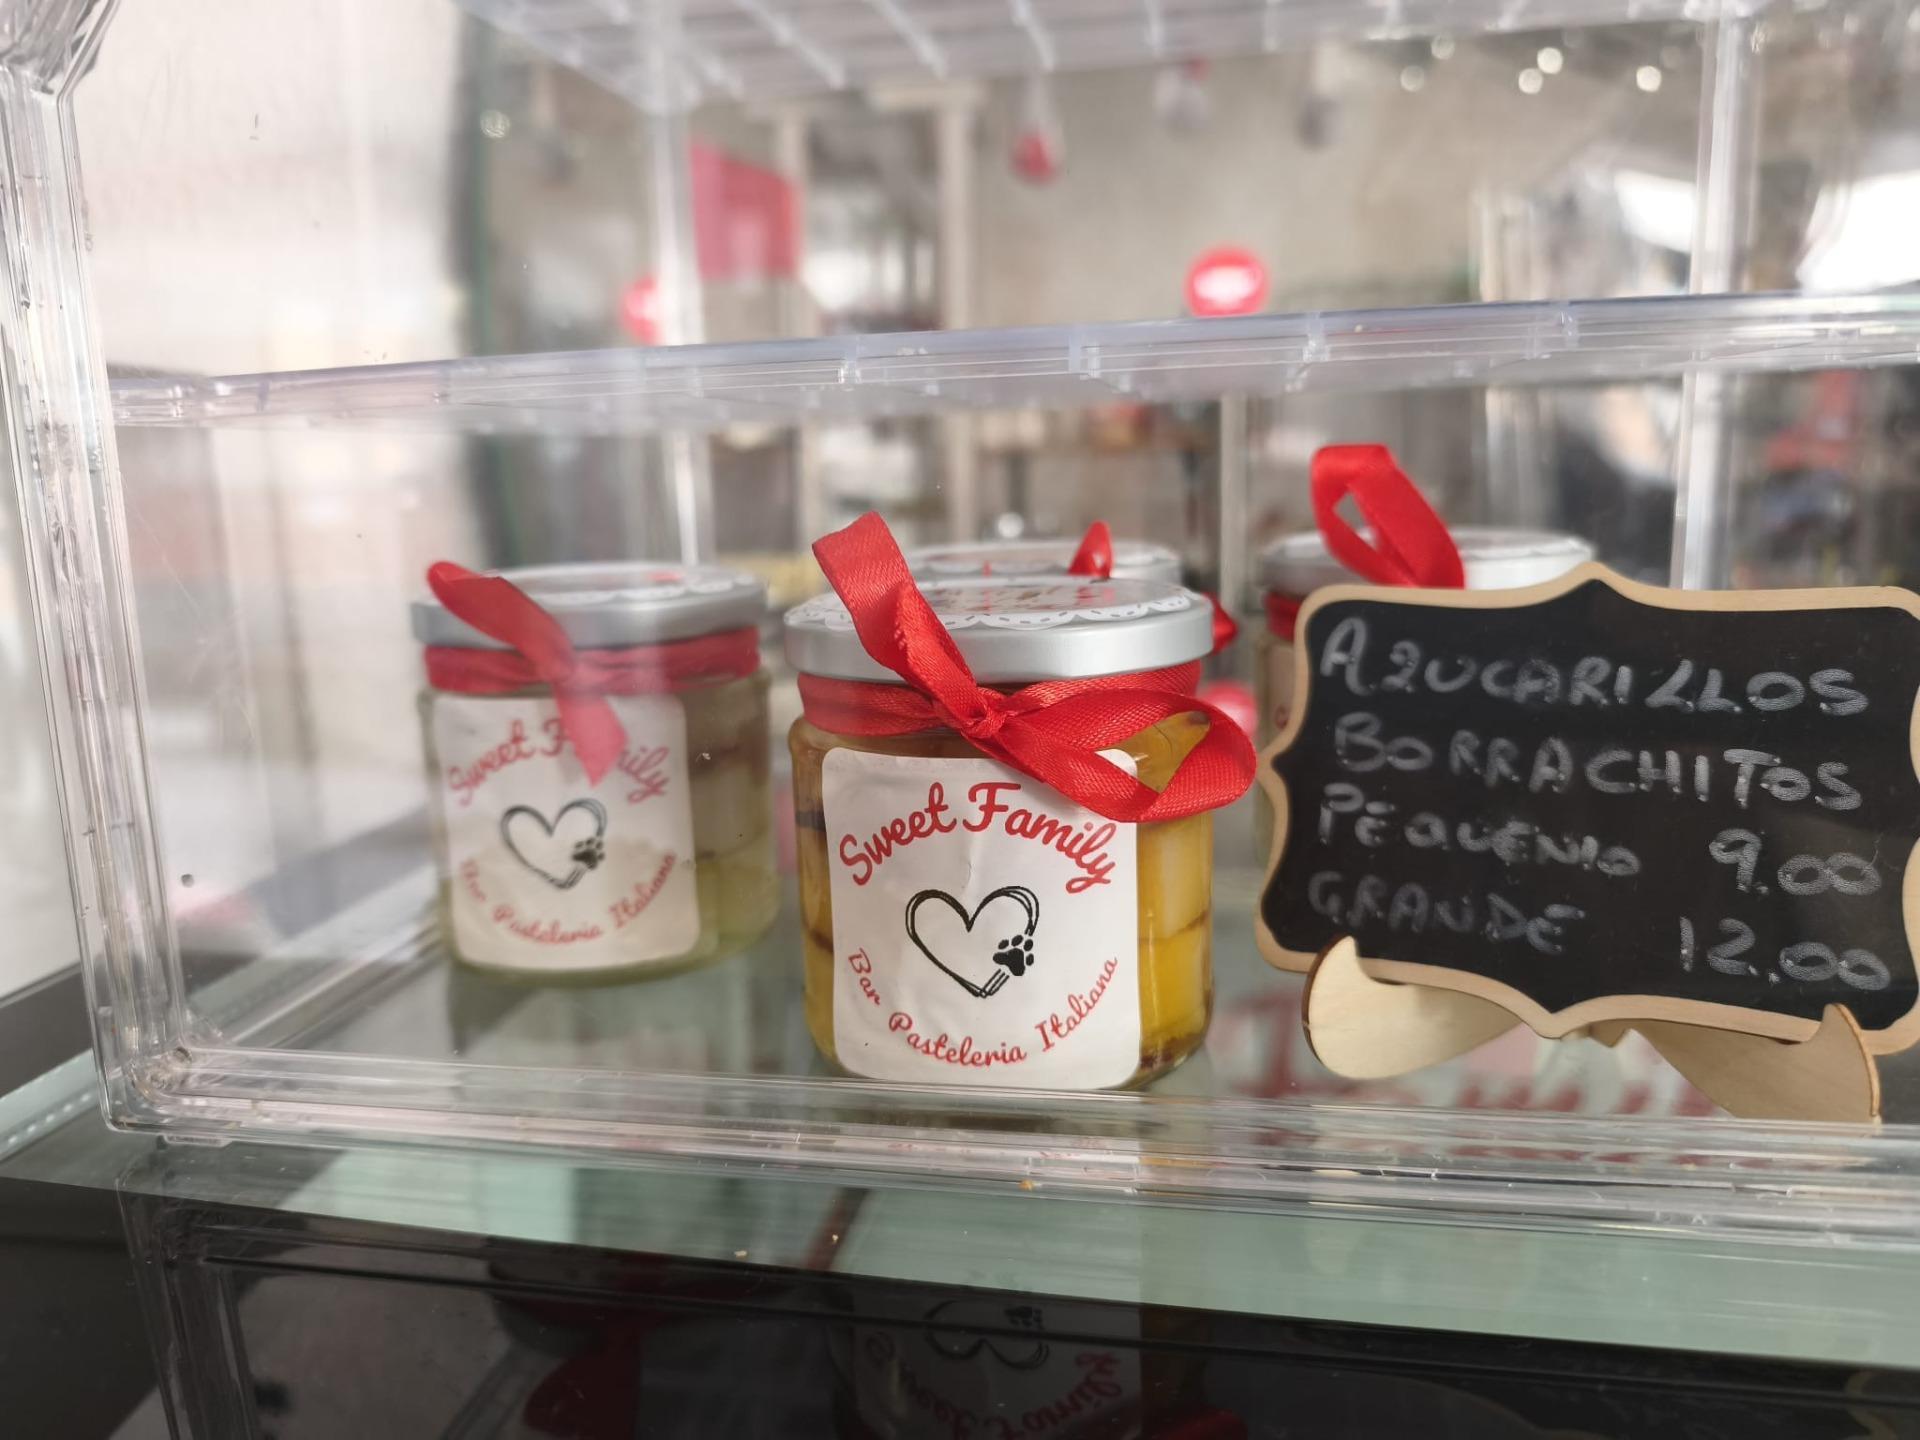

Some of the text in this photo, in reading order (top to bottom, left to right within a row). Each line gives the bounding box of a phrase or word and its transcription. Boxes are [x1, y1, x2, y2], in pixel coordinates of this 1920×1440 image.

[449, 718, 671, 807] Sweet Fily
[1334, 711, 1862, 810] BORRACHITOS
[839, 781, 1116, 894] Sweet Family
[1708, 828, 1882, 895] 9.00
[1307, 870, 1890, 990] GRANDE 12.00
[847, 946, 1119, 1067] Bar Pasteleria Italiana
